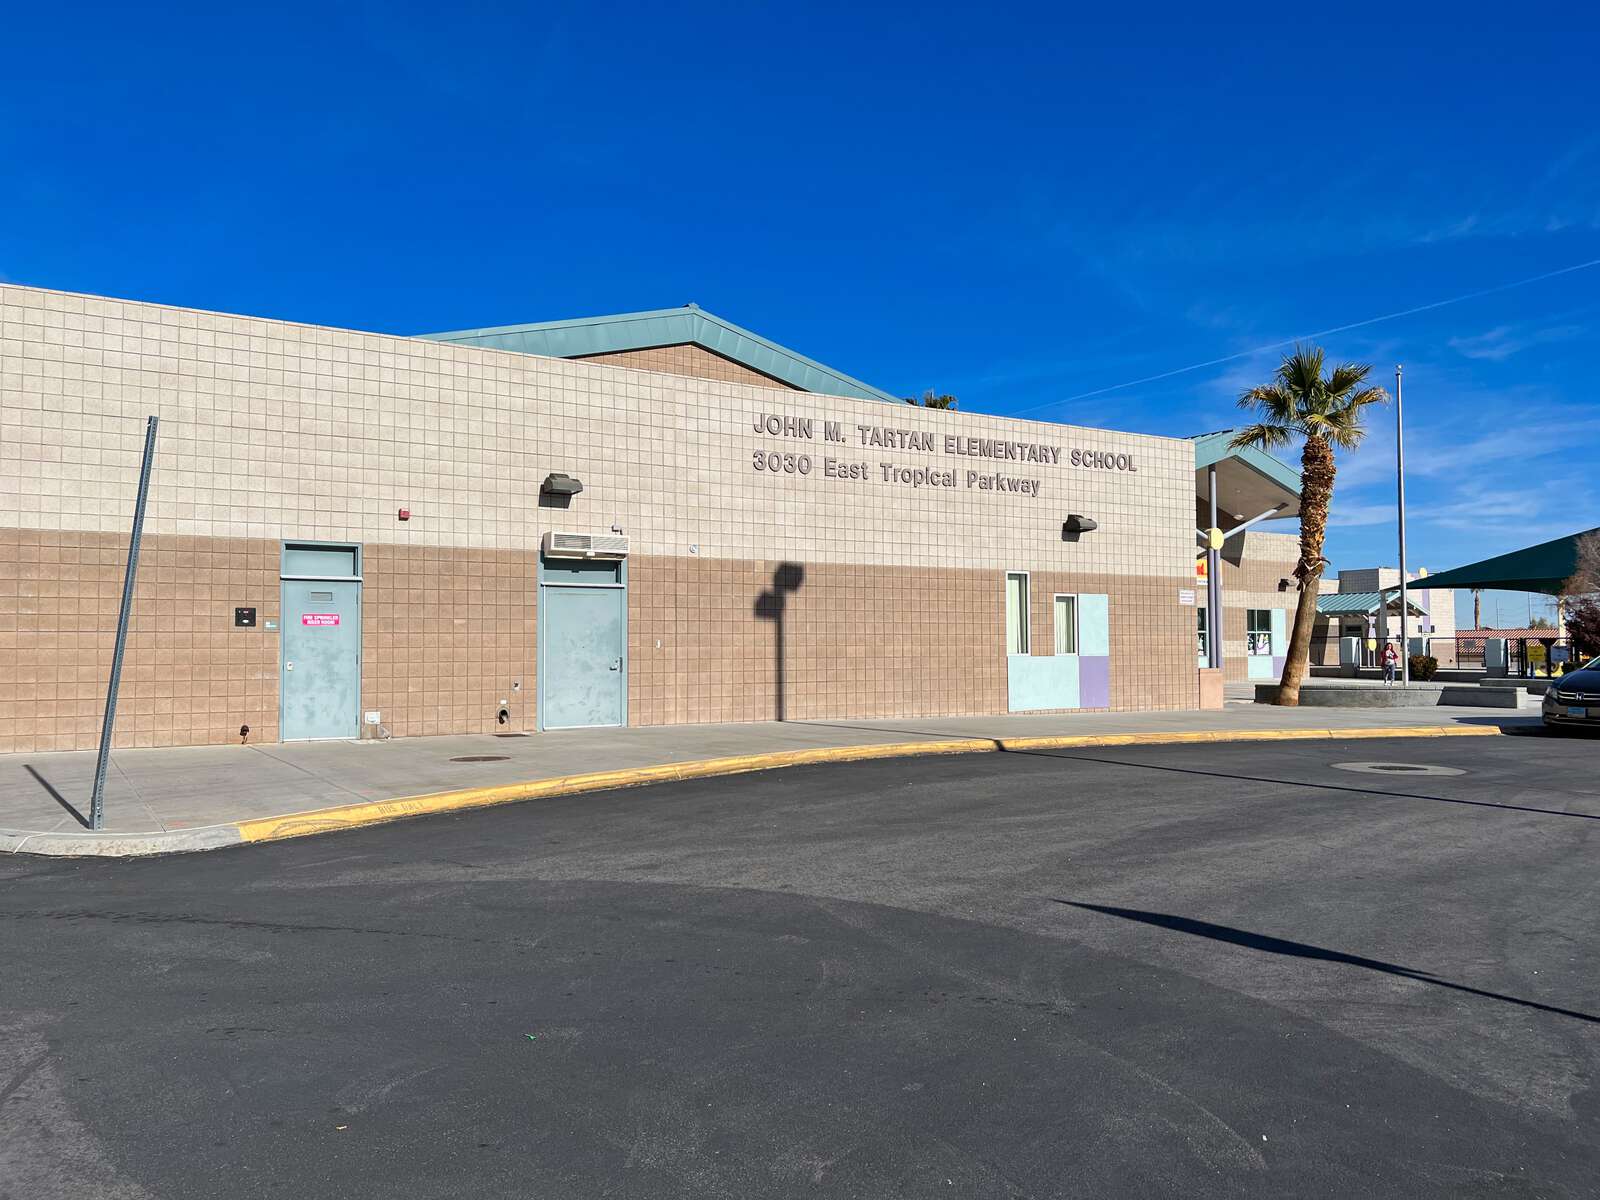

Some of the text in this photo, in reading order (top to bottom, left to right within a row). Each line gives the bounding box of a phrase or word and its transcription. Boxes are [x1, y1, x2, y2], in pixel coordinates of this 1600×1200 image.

[753, 412, 1137, 472] JOHN M. TARTAN ELEMENTARY SCHOOL
[752, 450, 1041, 498] 3030 East Tropical Parkway
